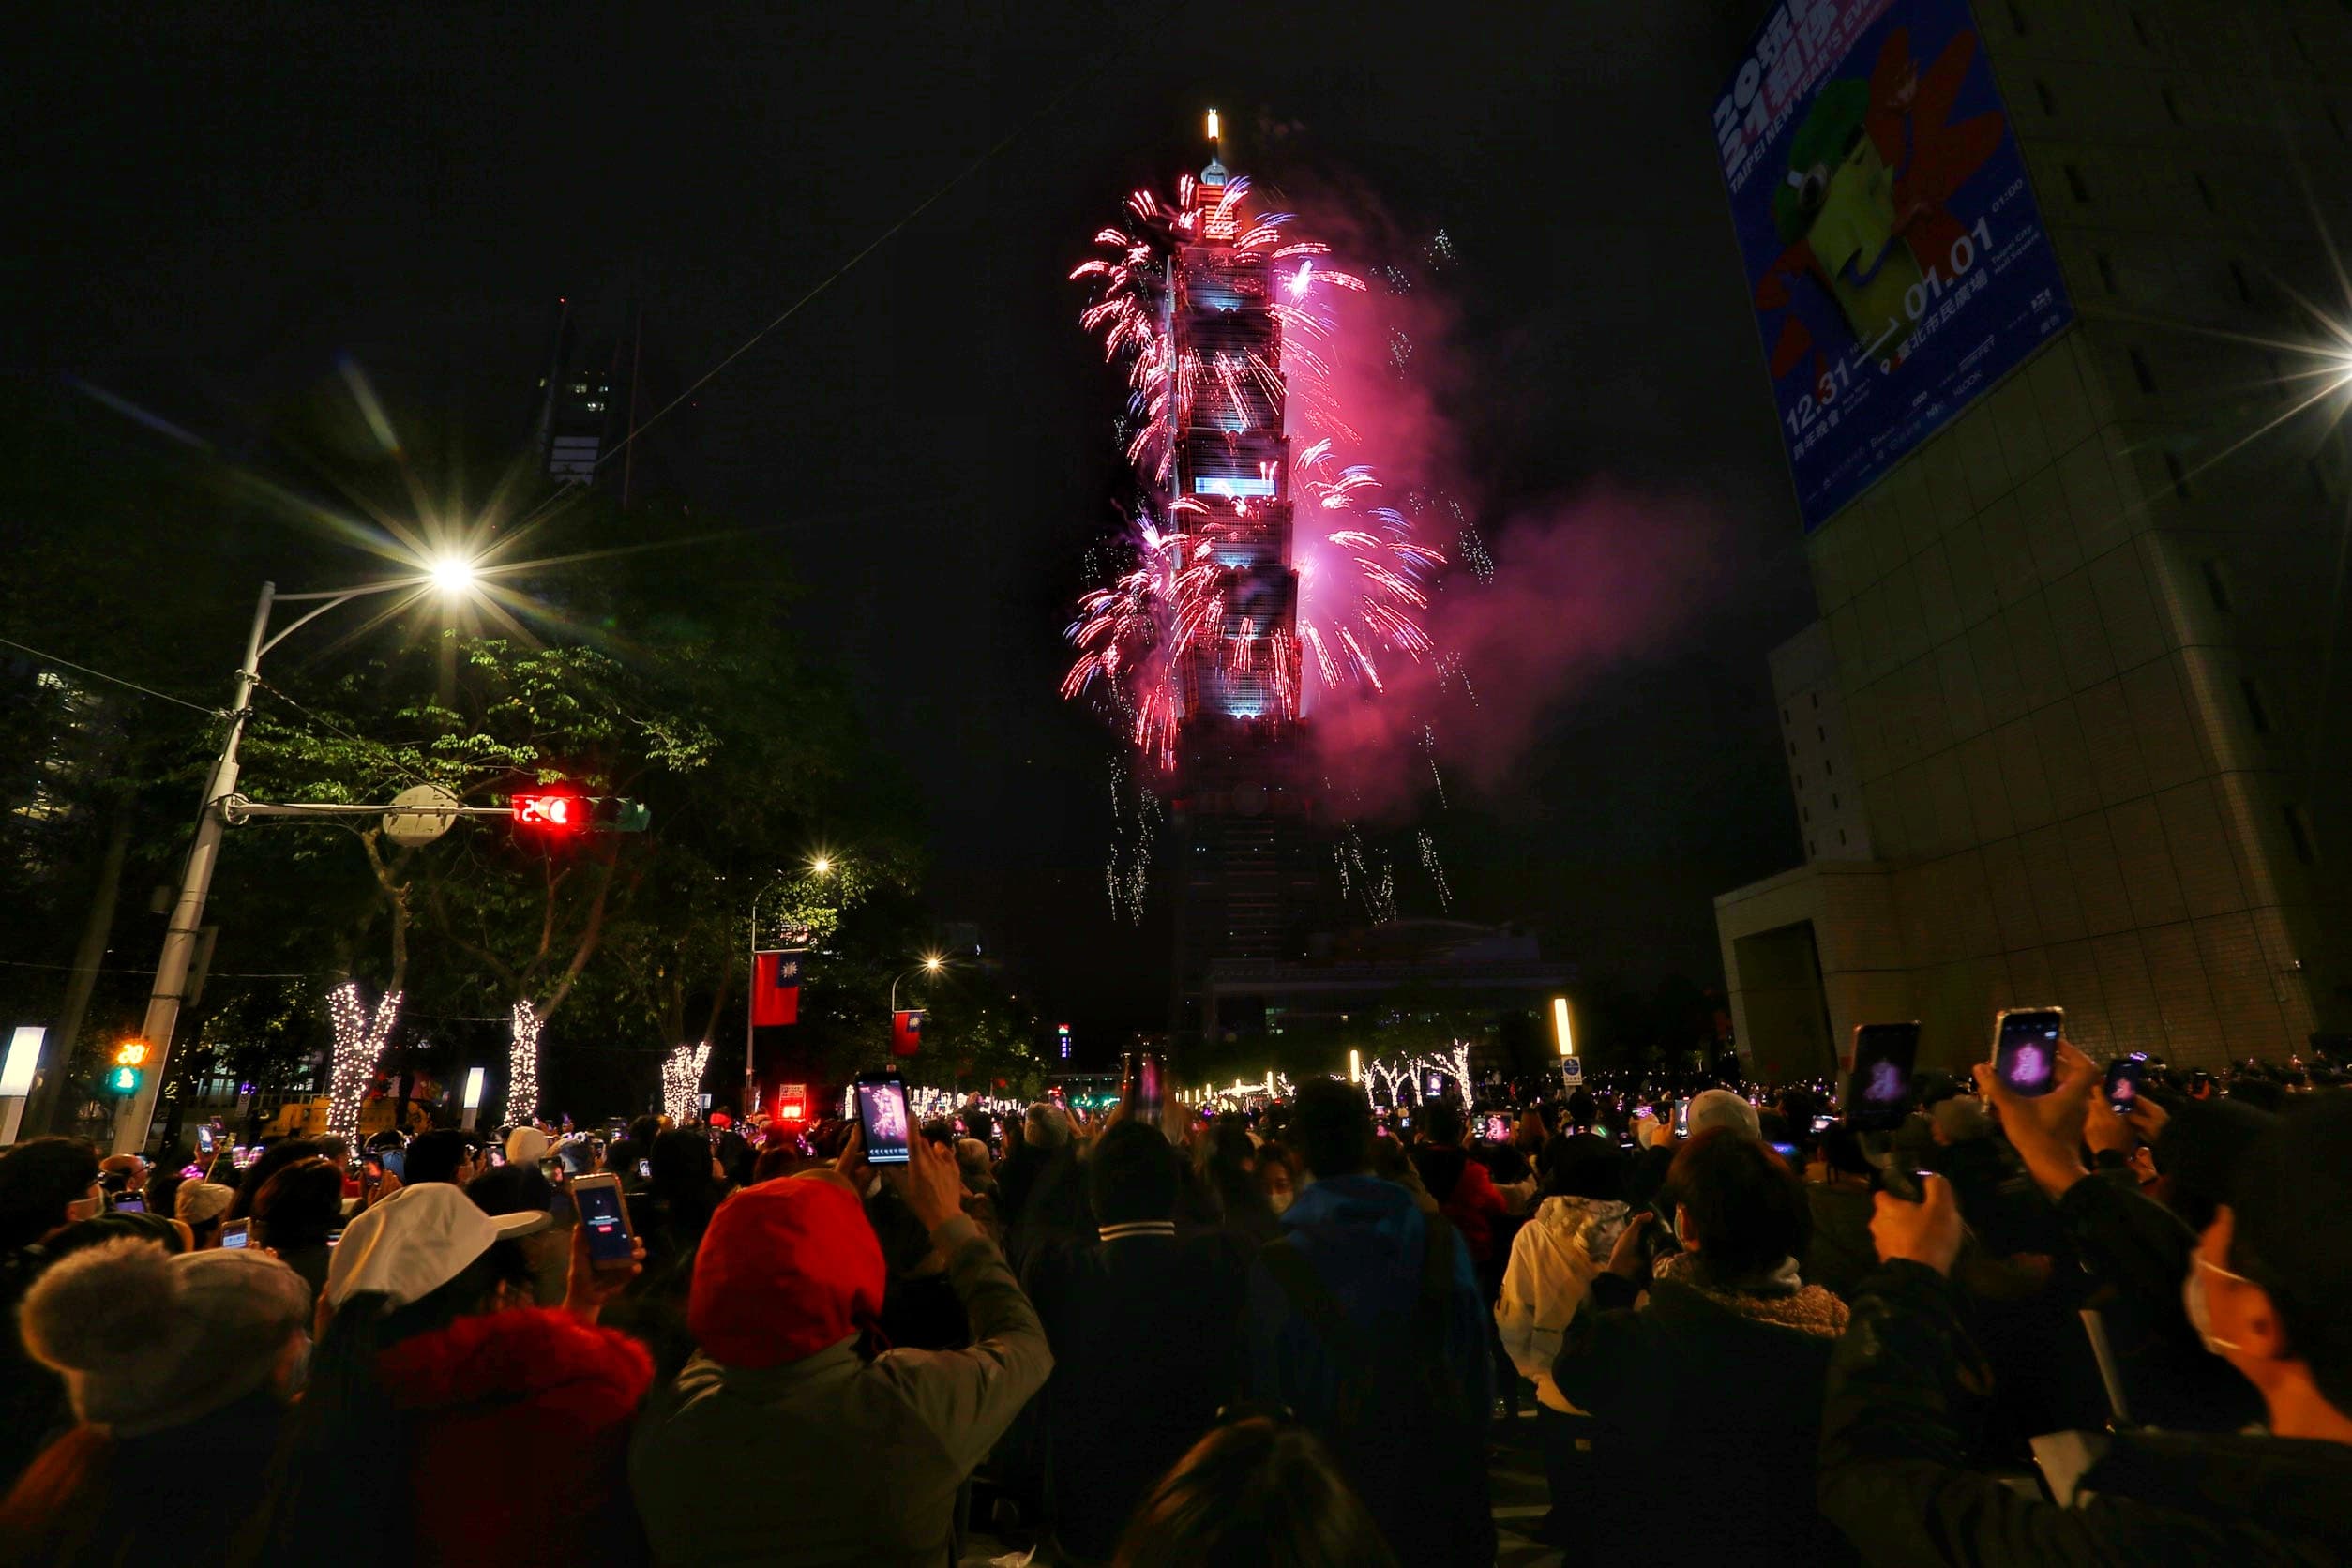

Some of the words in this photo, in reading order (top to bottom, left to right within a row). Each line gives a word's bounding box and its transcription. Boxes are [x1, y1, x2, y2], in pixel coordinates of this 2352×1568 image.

[1729, 138, 1767, 195] TAIPEI
[1766, 96, 1795, 146] NEW
[1794, 27, 1843, 101] YEAR'S
[1991, 178, 2023, 213] 01:00
[2014, 224, 2033, 242] City
[1904, 215, 1994, 321] 01.01
[1786, 356, 1850, 436] 12.31
